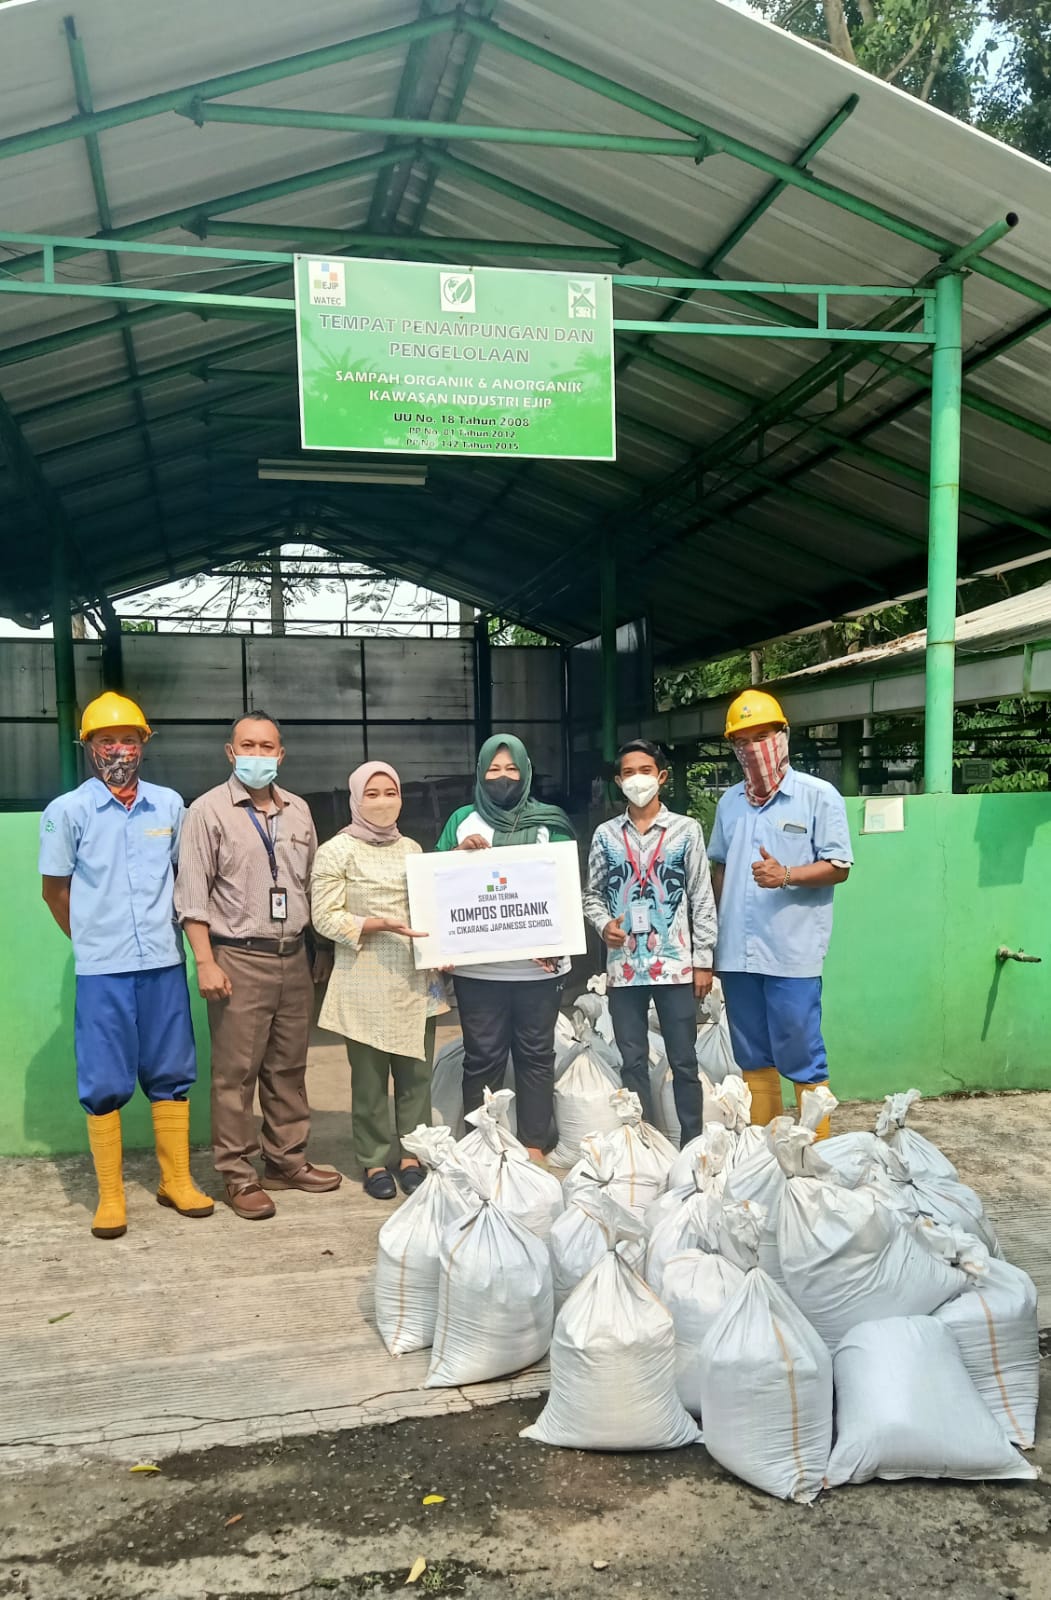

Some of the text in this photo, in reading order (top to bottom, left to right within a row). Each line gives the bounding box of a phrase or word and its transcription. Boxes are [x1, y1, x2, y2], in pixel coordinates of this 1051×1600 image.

[322, 281, 339, 290] EJIP
[313, 296, 342, 305] WATEC
[320, 314, 594, 343] TEMPAT PENAMPUNGAN DAN
[390, 343, 529, 362] PENGELOLAAN
[336, 370, 582, 393] SAMPAH ORGANIK & ANORGANIK
[369, 390, 552, 409] KAWASAN INDUSTRI EJIP
[394, 413, 529, 427] UU No. 18 Tahun 2008
[459, 429, 489, 437] Tahun
[492, 430, 515, 438] 2012
[463, 441, 492, 449] Tahun
[496, 442, 519, 450] 2015
[478, 892, 519, 903] SERAH TERIMA
[450, 901, 549, 923] KOMPOS ORGANIK
[456, 923, 489, 935] CIKARANG
[490, 920, 527, 932] JAPANESSE
[528, 918, 553, 929] SCHOOL
